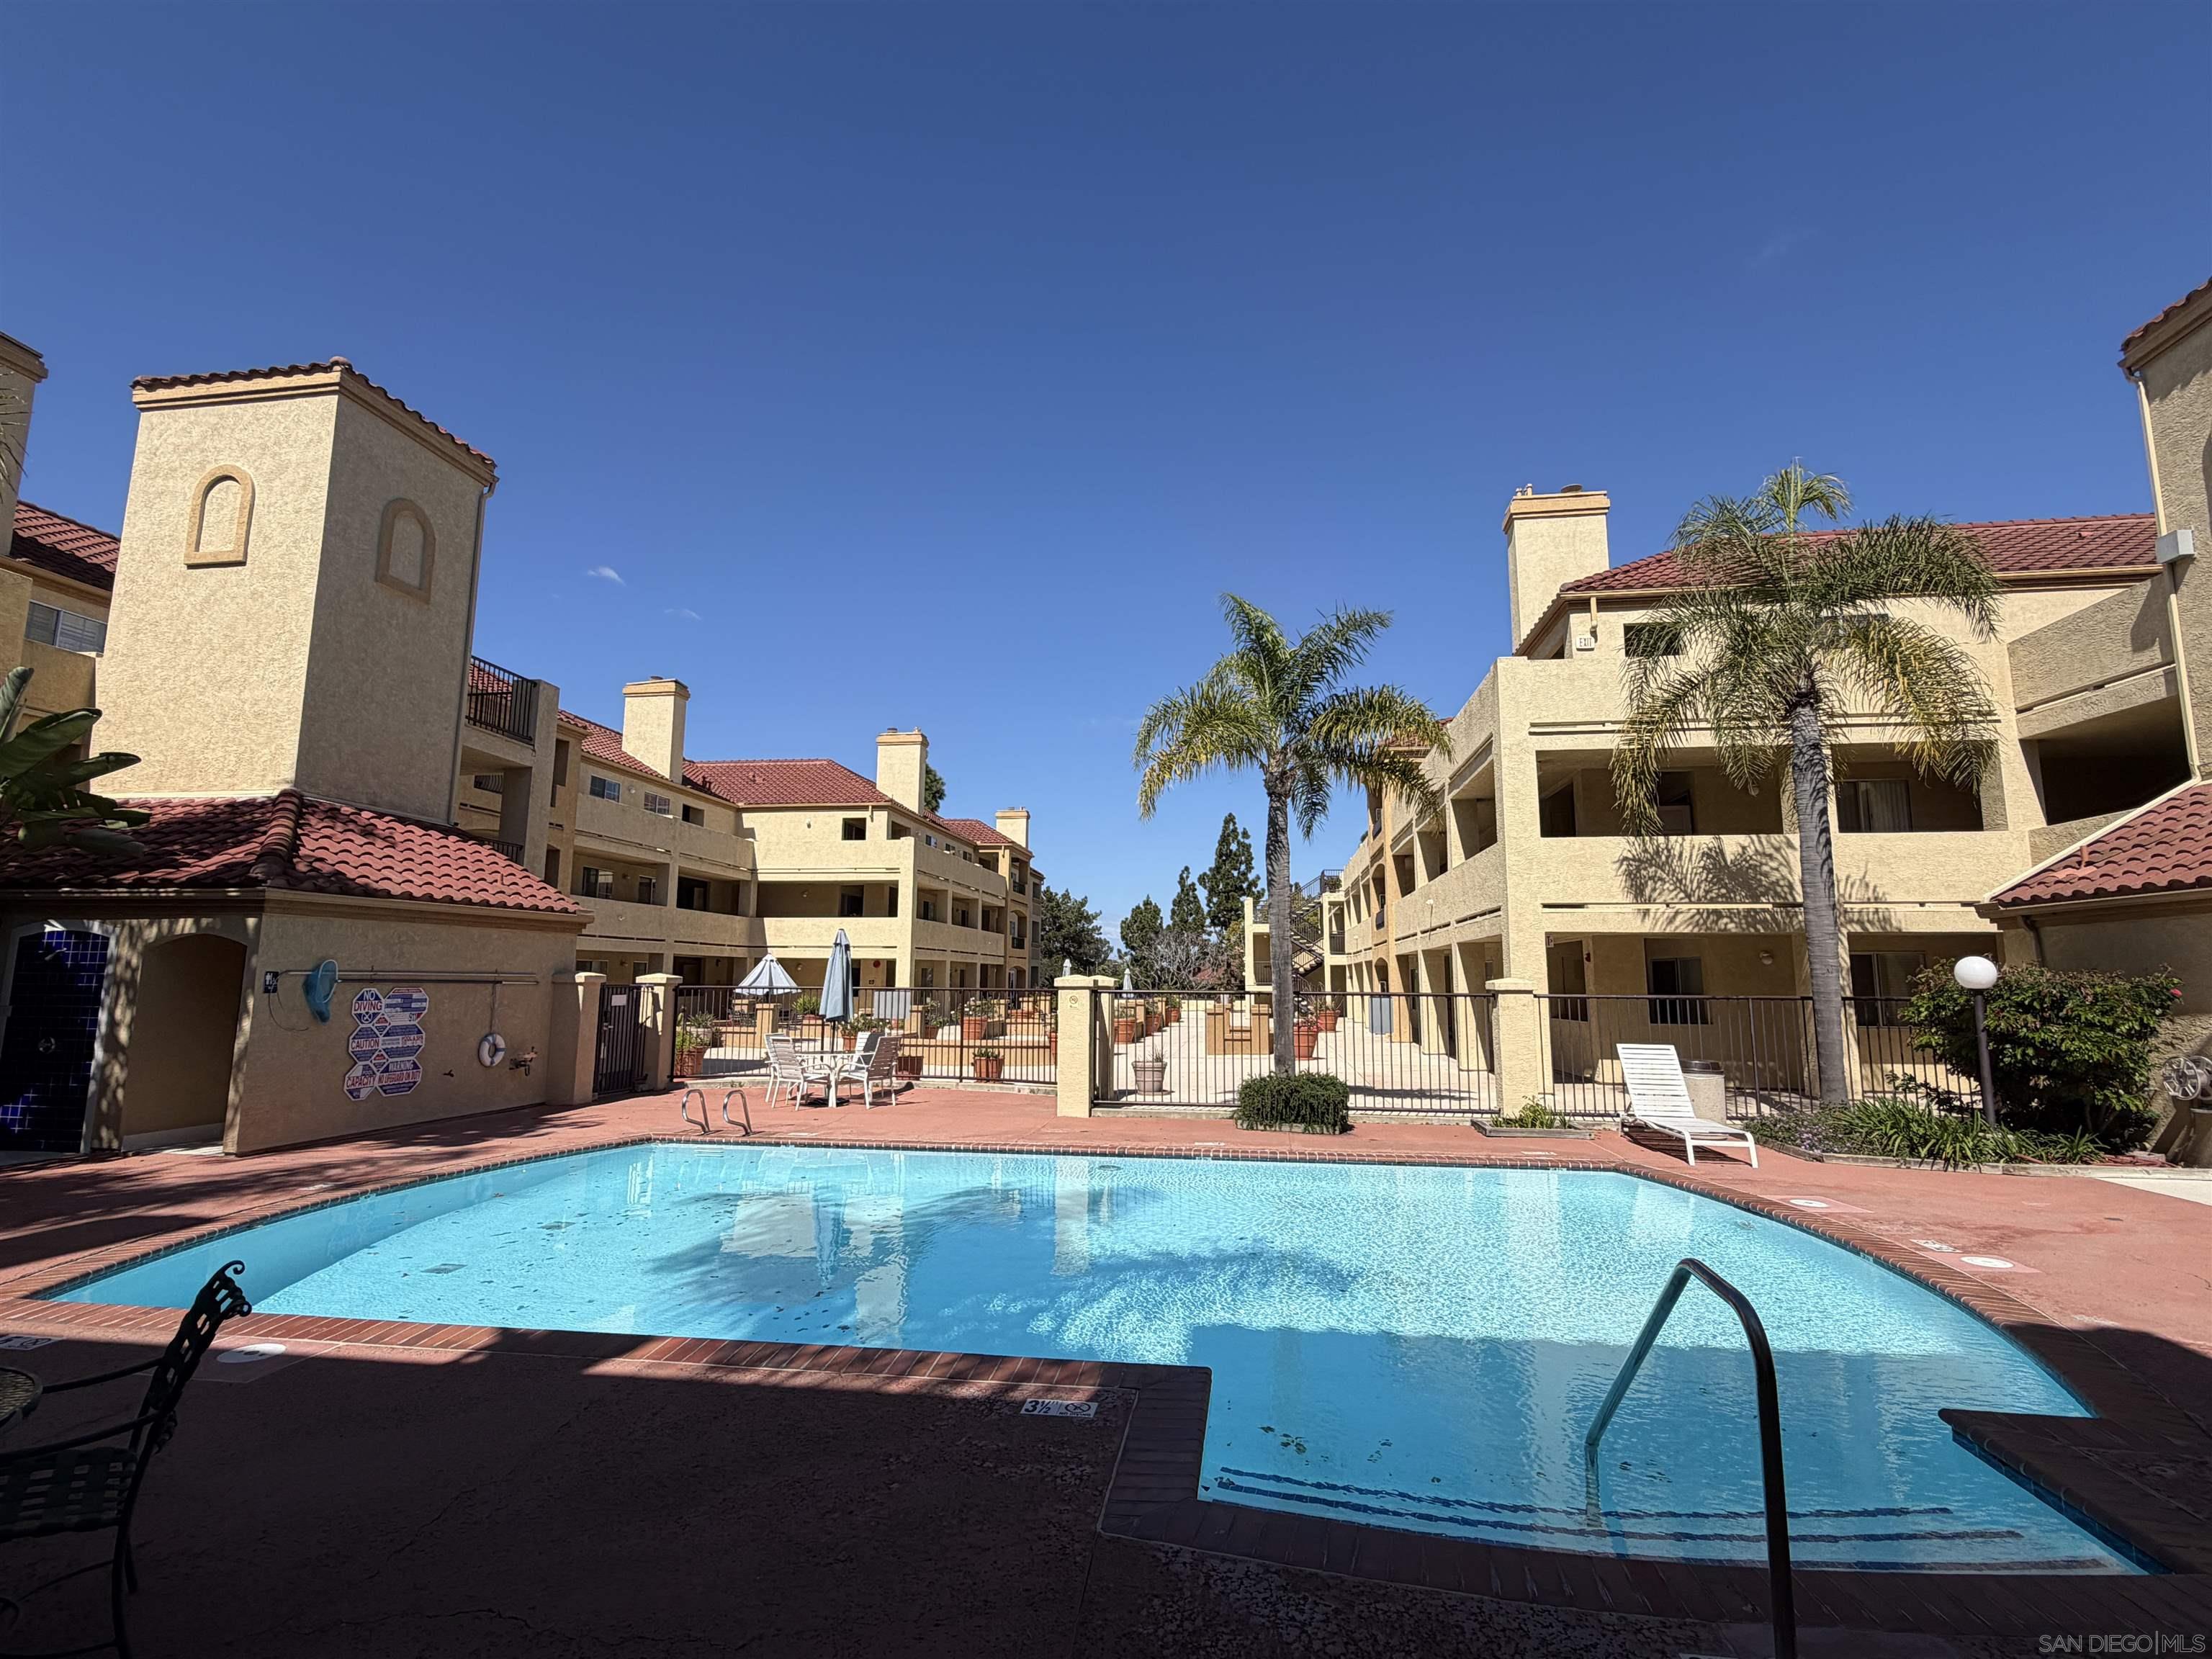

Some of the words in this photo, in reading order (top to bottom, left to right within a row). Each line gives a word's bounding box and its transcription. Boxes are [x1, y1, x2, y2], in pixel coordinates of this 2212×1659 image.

[1579, 637, 1592, 647] EXIT
[363, 990, 375, 1000] NO
[354, 1001, 382, 1011] DIVING
[351, 1038, 379, 1050] CAUTION
[389, 1061, 414, 1072] WARNING
[346, 1075, 375, 1088] CAPACITY
